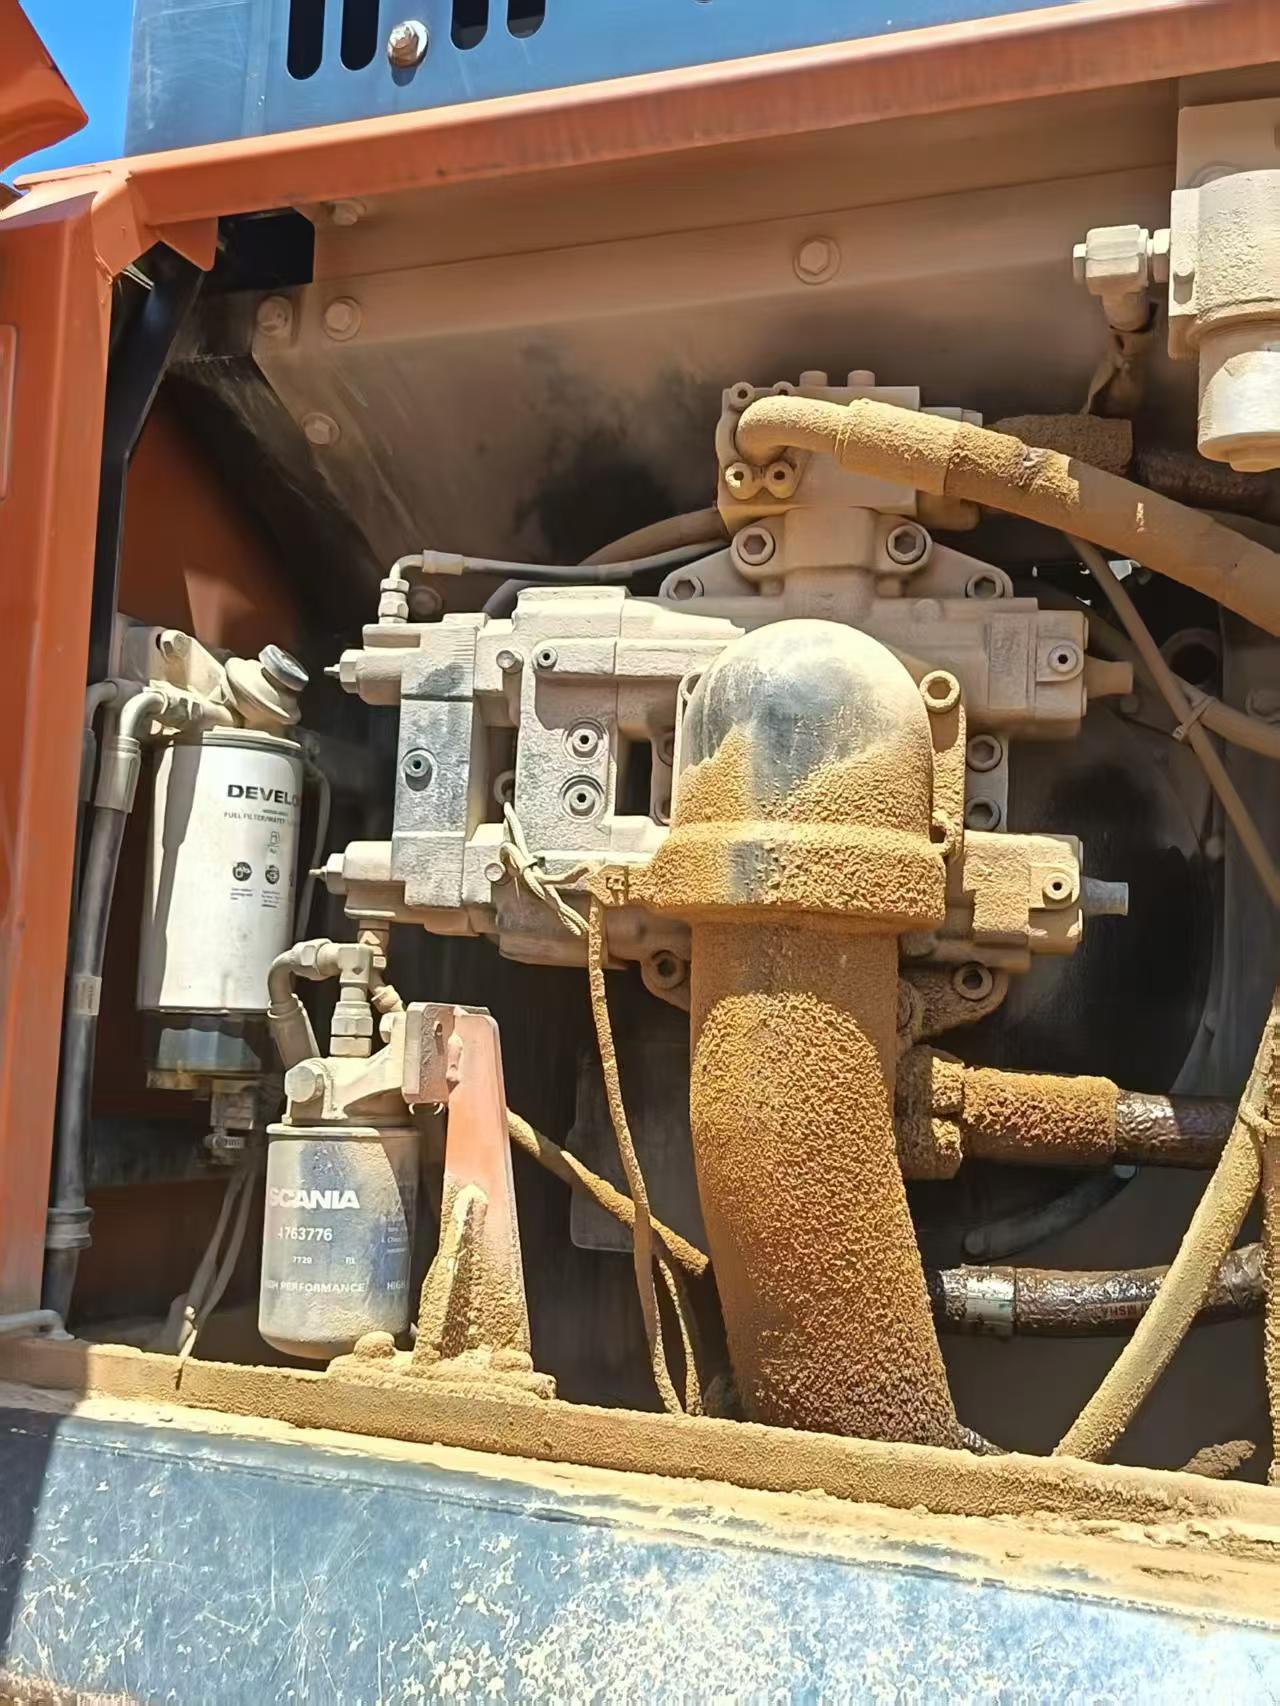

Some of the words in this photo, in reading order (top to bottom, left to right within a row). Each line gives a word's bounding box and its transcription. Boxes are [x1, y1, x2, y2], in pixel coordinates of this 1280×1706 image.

[224, 811, 242, 819] FUEL
[269, 1188, 361, 1210] SCANIA
[280, 1281, 366, 1294] PERFORMANCE
